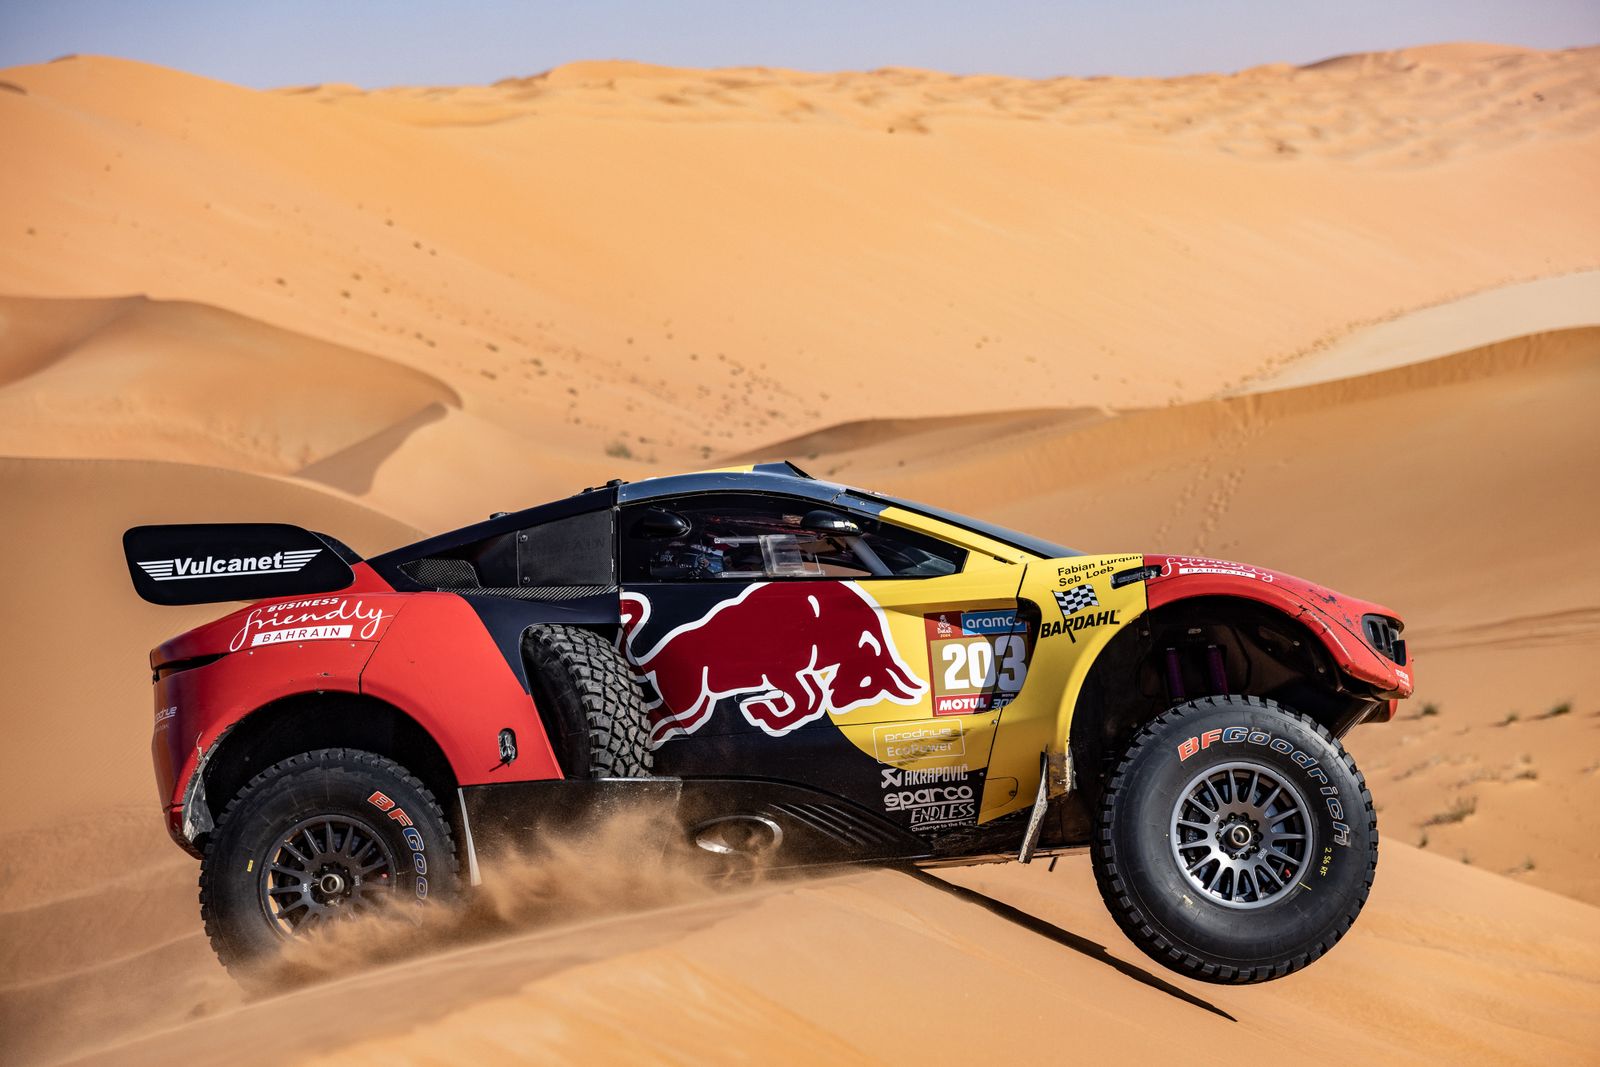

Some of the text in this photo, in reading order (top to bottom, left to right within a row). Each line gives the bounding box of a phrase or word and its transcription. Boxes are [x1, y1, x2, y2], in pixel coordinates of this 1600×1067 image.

[173, 551, 285, 576] Vulcanet
[1057, 554, 1143, 577] Fabian Lurquin
[1058, 566, 1115, 587] Seb Loeb
[267, 597, 340, 613] BUSINESS
[229, 599, 394, 652] friendly
[262, 626, 341, 643] BAHRAIN
[1040, 609, 1121, 641] BARDAHL
[942, 635, 1027, 691] 203
[939, 697, 987, 711] MOTUL
[885, 728, 951, 743] prodrive
[887, 743, 953, 757] EcoPower
[1177, 726, 1351, 846] BFGoodrich
[884, 785, 973, 811] sparco
[910, 803, 975, 824] ENDLESS
[367, 791, 428, 904] BFGoo
